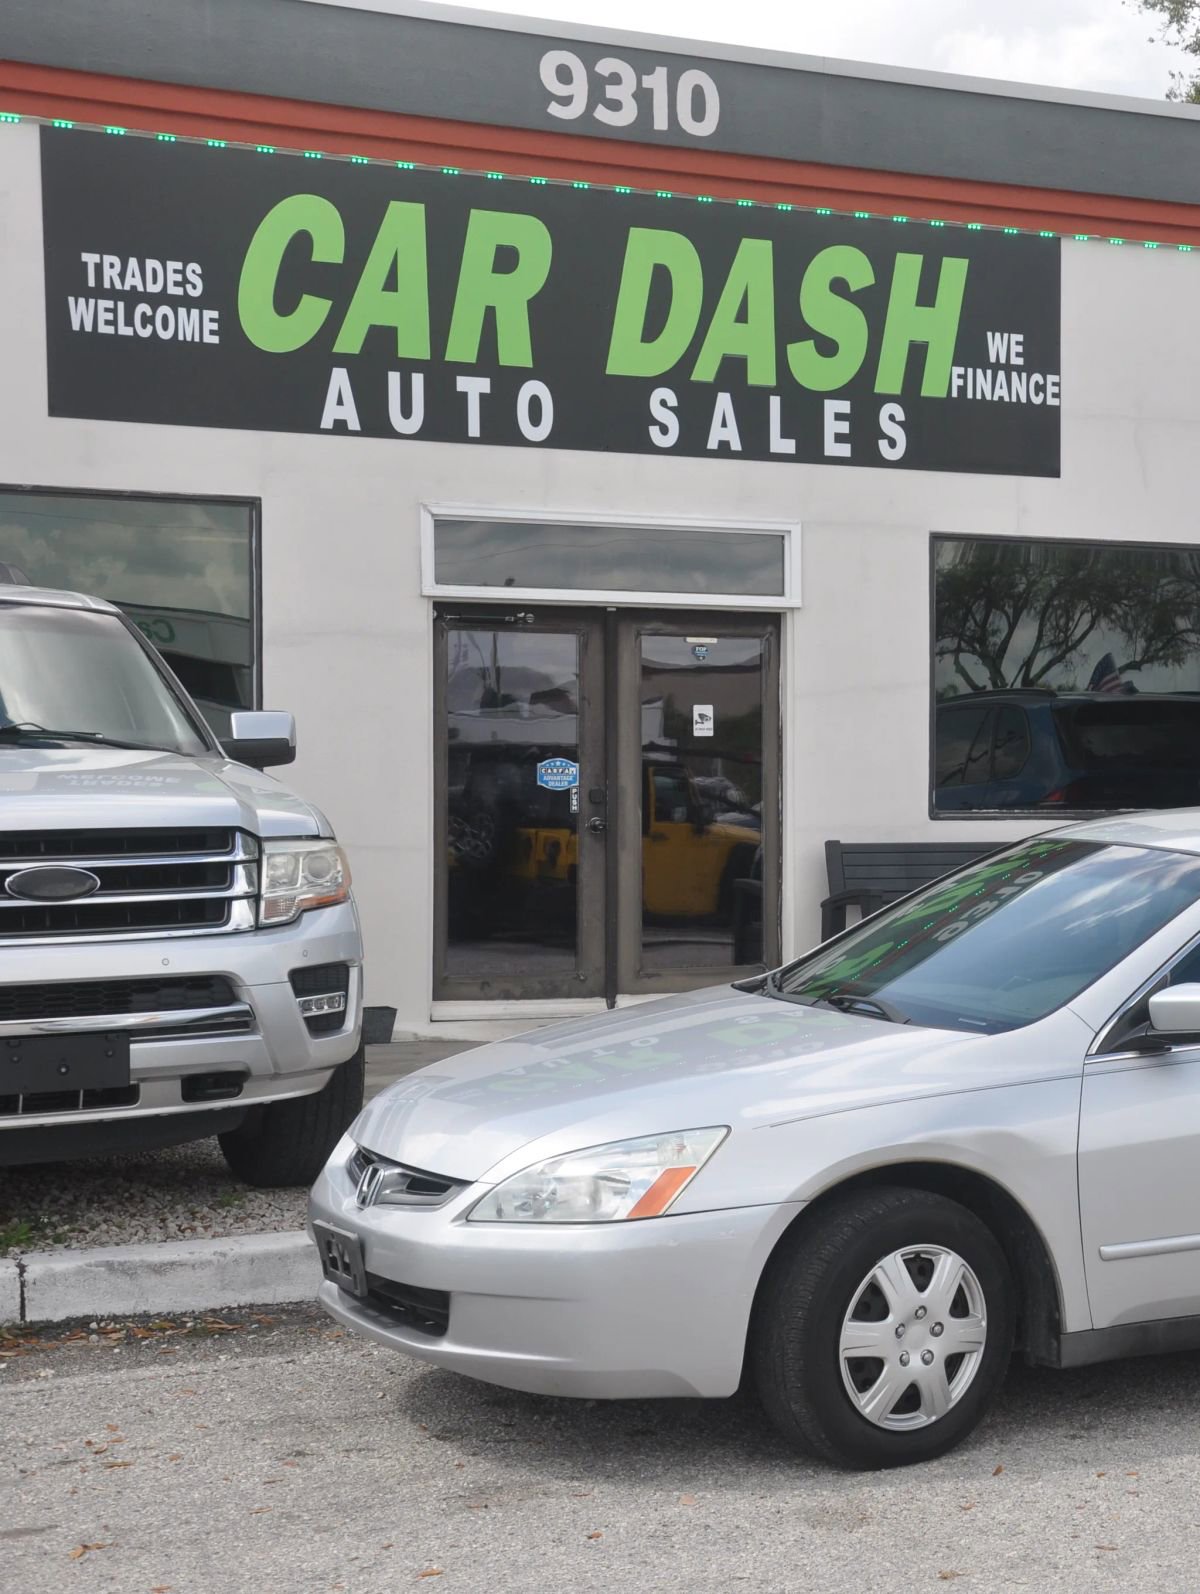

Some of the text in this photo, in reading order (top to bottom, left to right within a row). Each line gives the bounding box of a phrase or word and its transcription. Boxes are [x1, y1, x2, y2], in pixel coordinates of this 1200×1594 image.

[539, 50, 721, 137] 9310
[81, 252, 204, 297] TRADES
[238, 193, 969, 398] CAR DASH
[67, 297, 220, 345] WELCOME
[987, 331, 1024, 366] WE
[951, 366, 1061, 406] FINANCE
[320, 367, 908, 461] AUTO SALES
